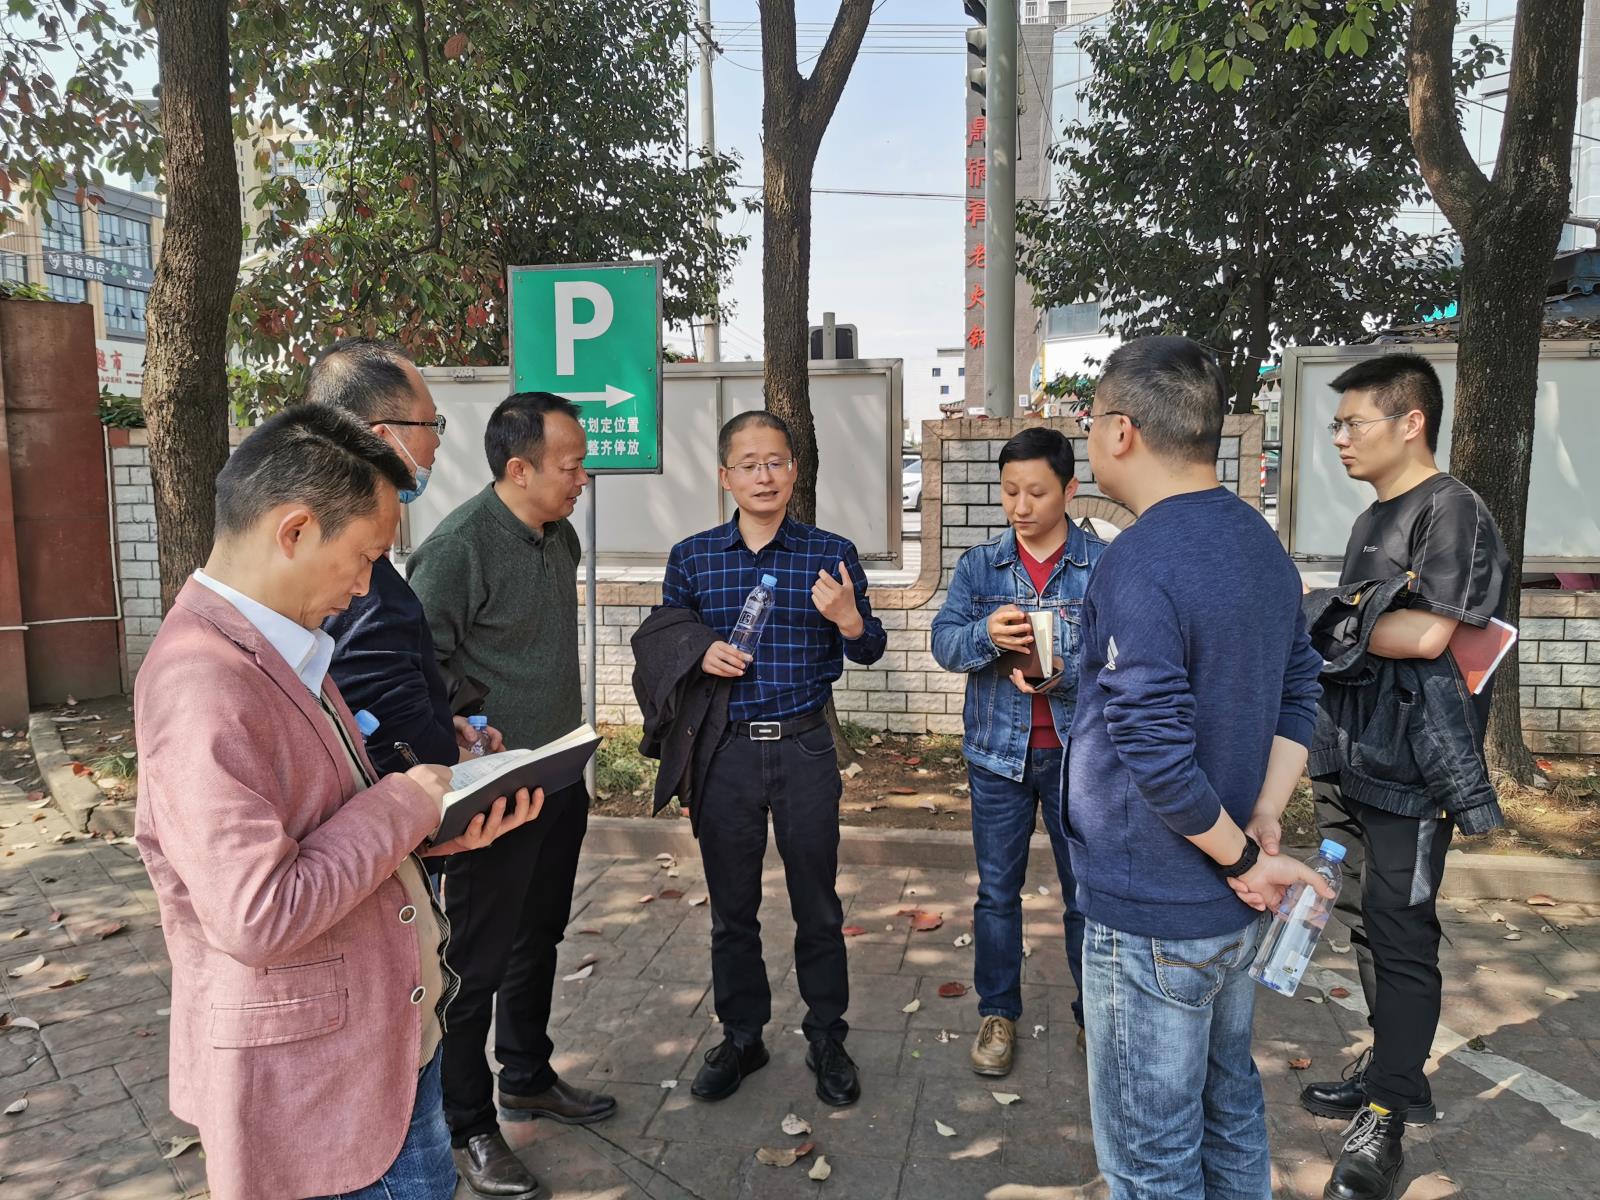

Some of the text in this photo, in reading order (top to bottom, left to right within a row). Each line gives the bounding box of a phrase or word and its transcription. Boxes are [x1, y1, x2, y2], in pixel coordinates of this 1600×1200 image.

[554, 281, 614, 376] P
[587, 439, 640, 456] 整齐停放
